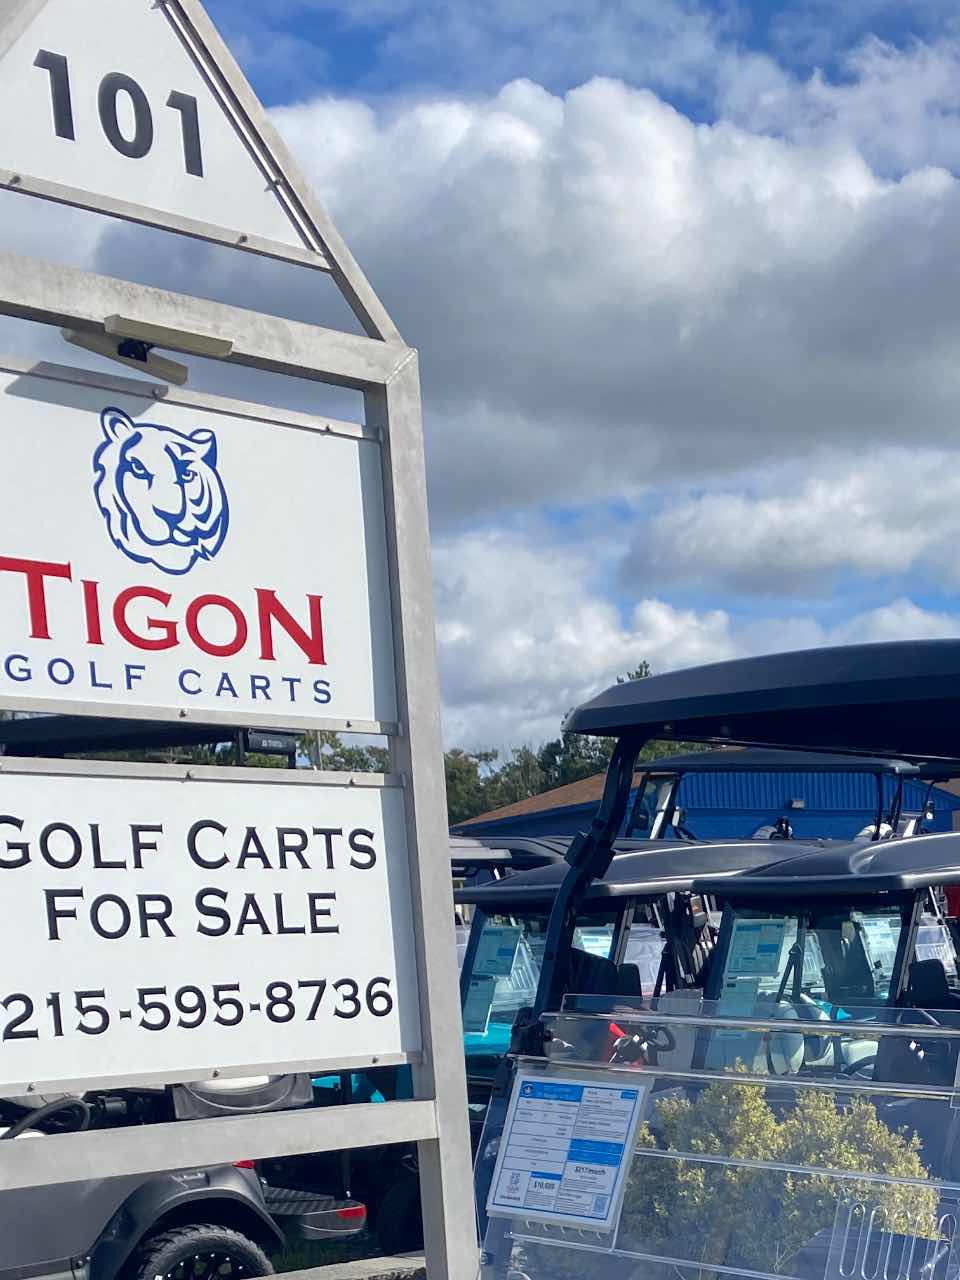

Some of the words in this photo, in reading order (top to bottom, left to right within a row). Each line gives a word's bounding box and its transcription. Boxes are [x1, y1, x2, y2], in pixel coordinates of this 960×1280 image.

[33, 48, 204, 179] 101
[0, 555, 328, 666] TIGON
[4, 654, 146, 691] GOLF
[178, 668, 333, 704] CARTS
[0, 814, 164, 870] GOLF
[186, 819, 378, 870] CARTS
[43, 886, 177, 941] FOR
[195, 886, 340, 937] SALE
[2, 976, 394, 1043] 215-595-8736
